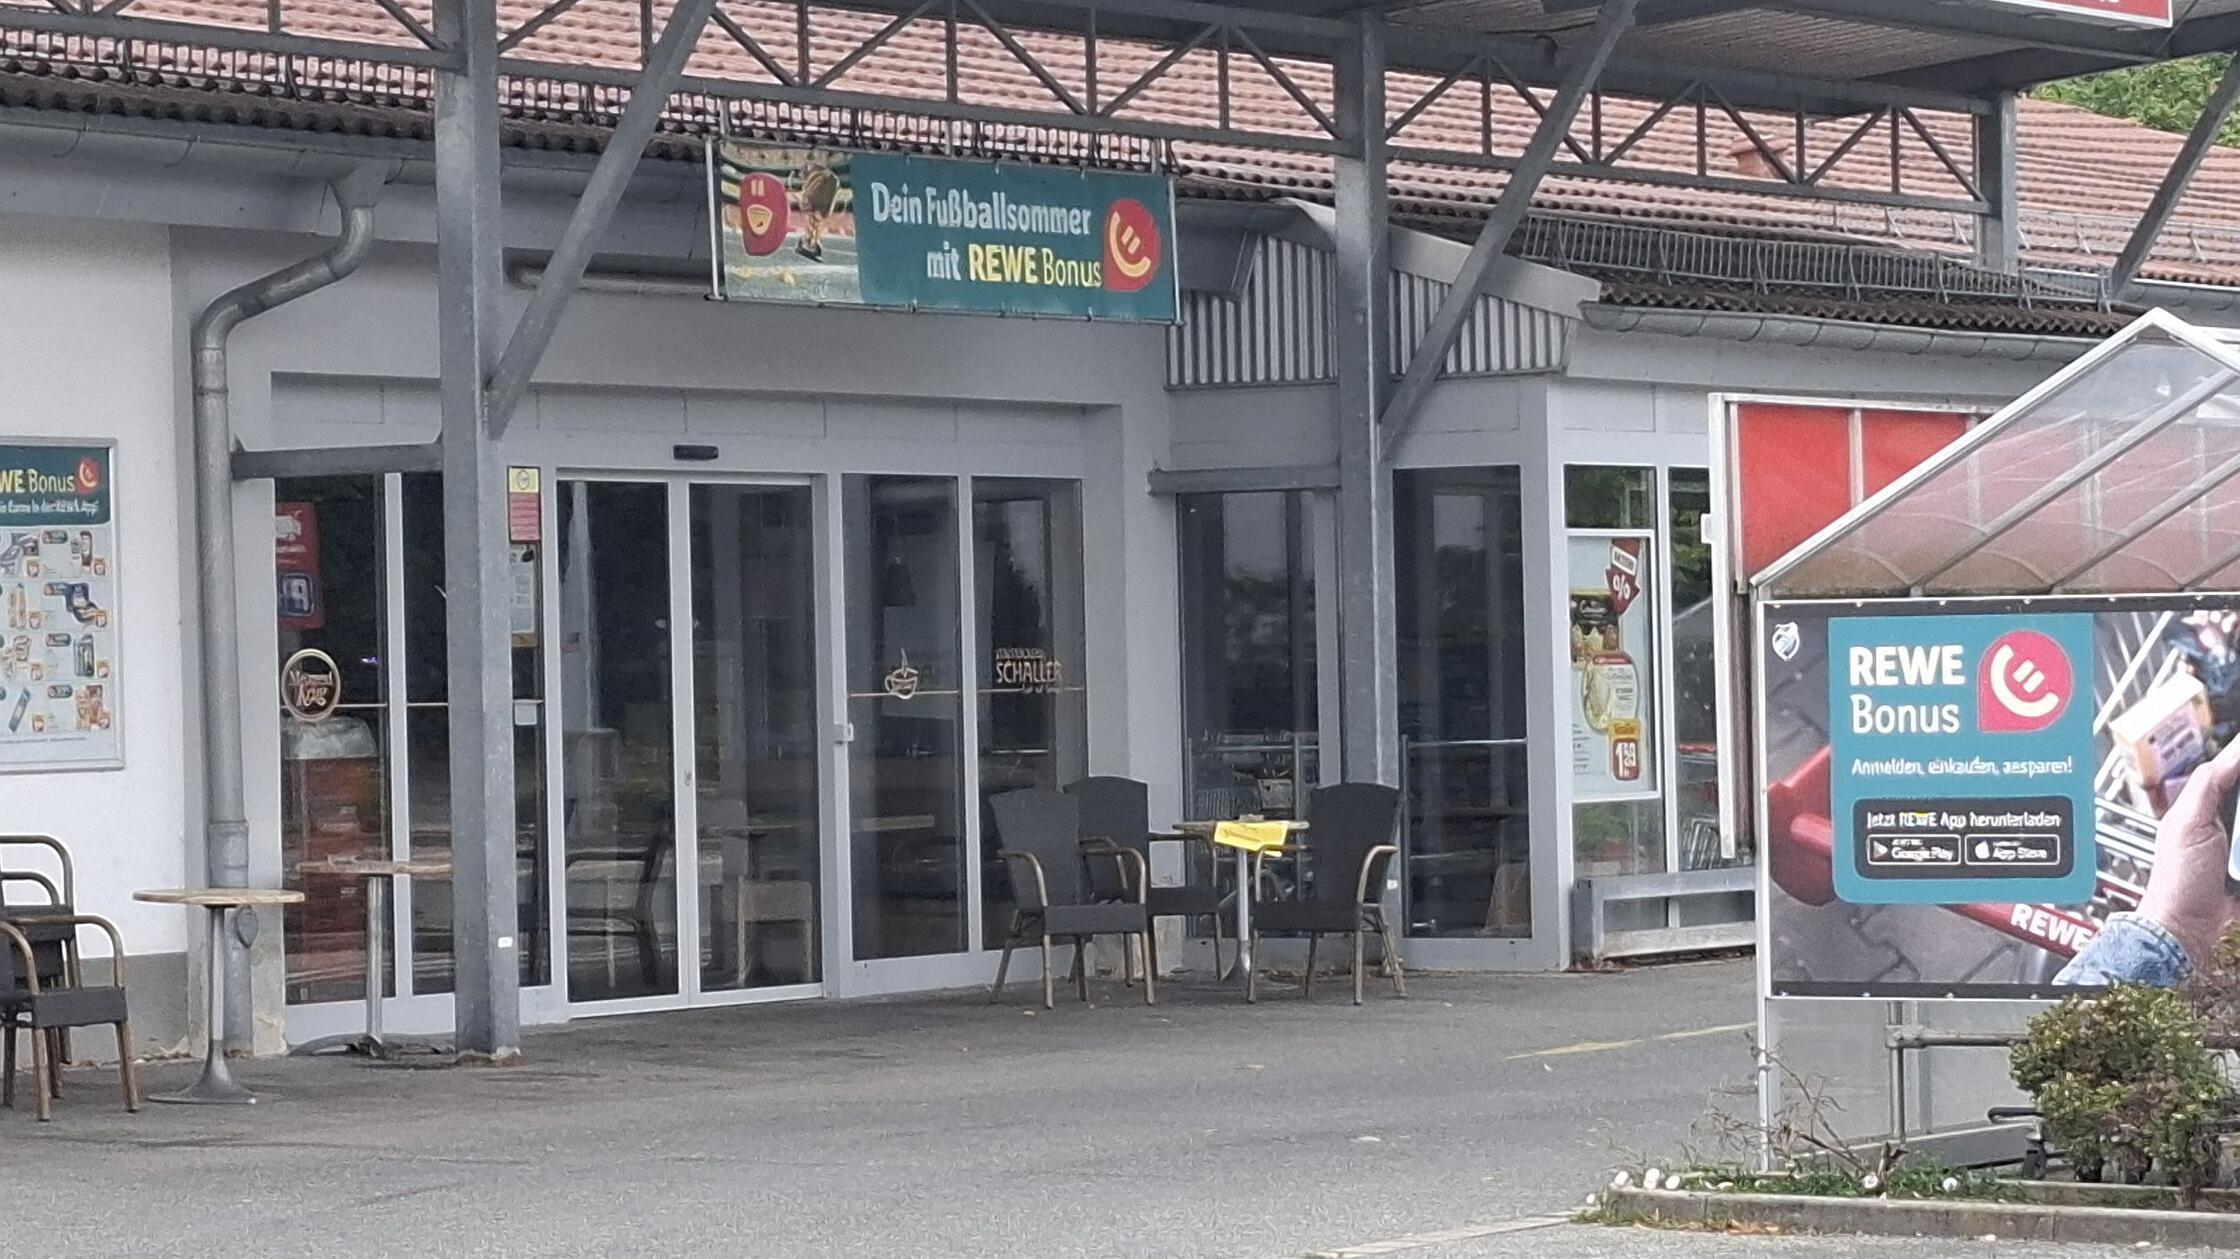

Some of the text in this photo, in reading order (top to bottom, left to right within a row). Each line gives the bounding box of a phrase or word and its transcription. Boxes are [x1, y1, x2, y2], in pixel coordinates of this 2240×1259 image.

[871, 182, 1092, 235] Dein Fußballsommer
[926, 241, 1102, 288] mit REWE Bonus
[27, 468, 76, 494] Bonus
[996, 660, 1062, 684] SCHALLER
[1850, 645, 1966, 686] REWE
[1850, 693, 1960, 733] Bonus
[1851, 758, 1925, 776] Anmelden,
[1899, 812, 1938, 828] REWE
[1940, 812, 1967, 830] App
[1969, 812, 2062, 829] herunterladen
[2010, 903, 2094, 952] REWE
